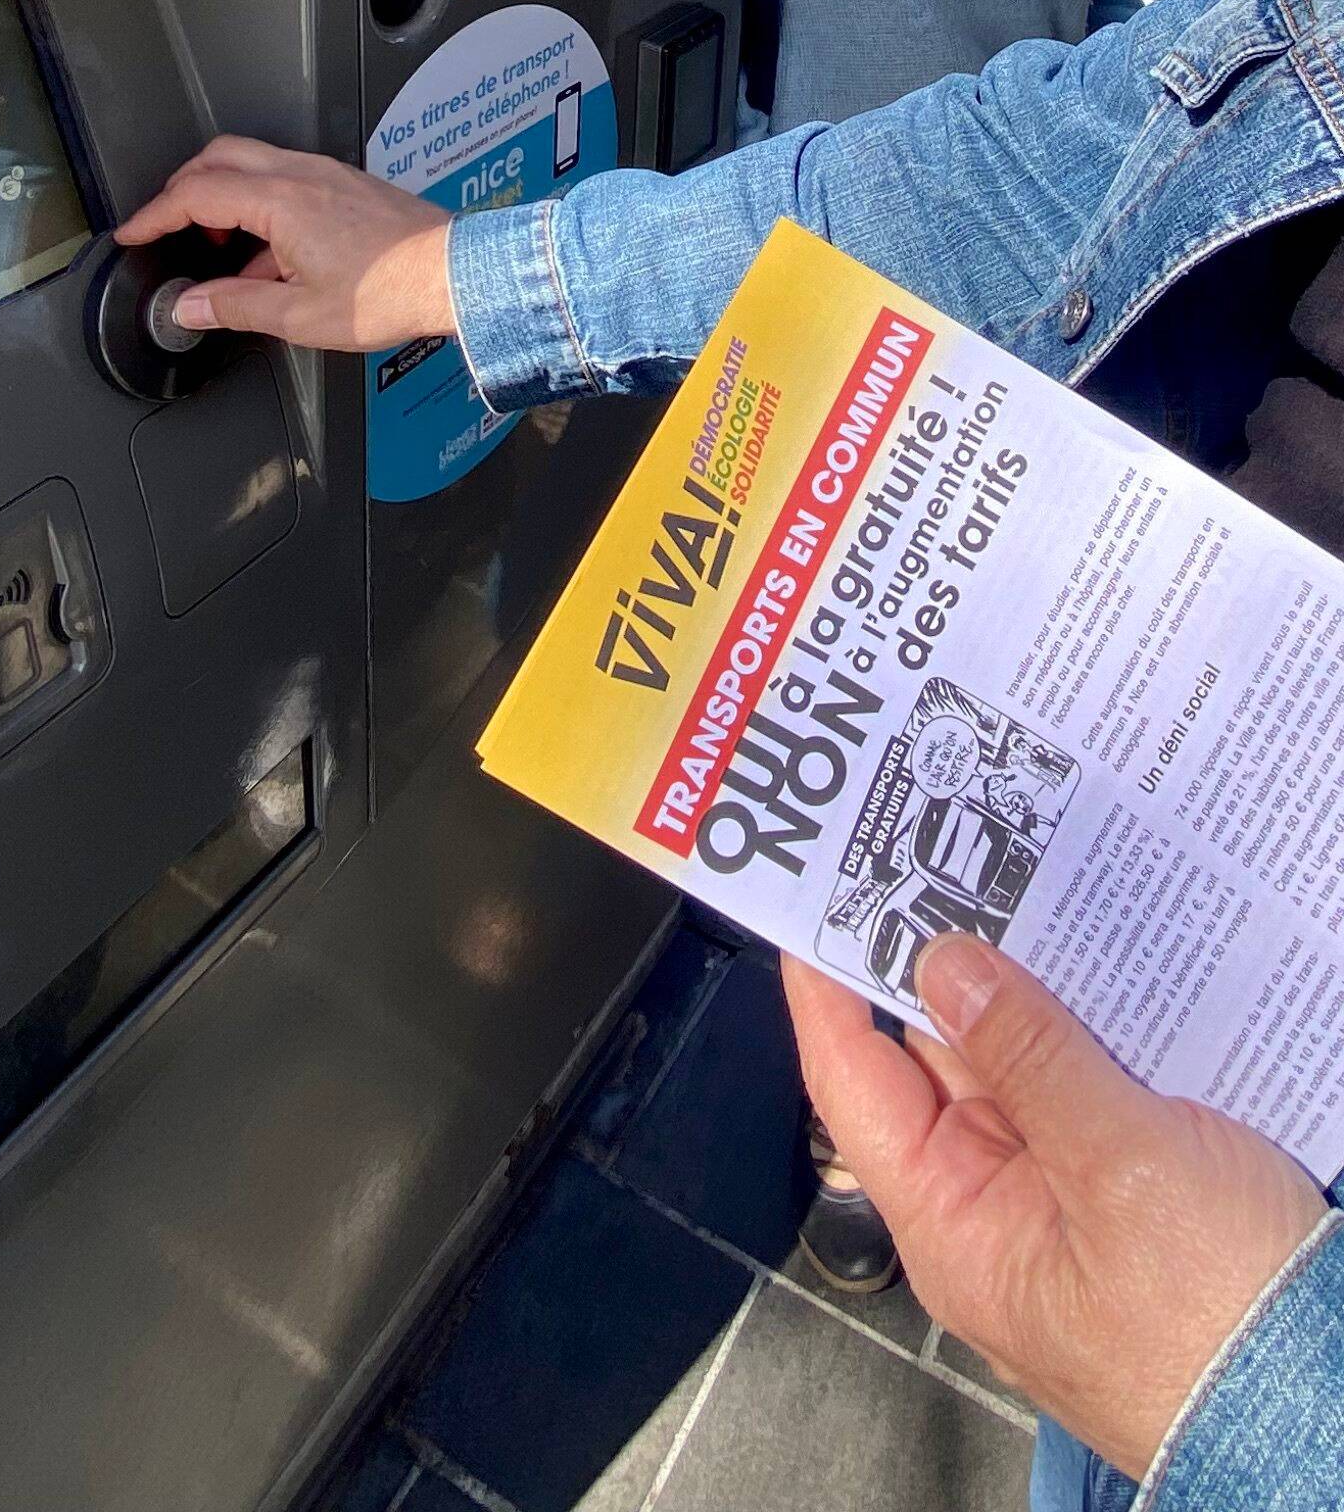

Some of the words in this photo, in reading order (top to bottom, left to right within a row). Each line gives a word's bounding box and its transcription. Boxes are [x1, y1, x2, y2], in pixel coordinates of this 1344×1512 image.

[380, 119, 415, 152] Vos
[422, 89, 470, 129] titres
[475, 74, 497, 99] de
[503, 33, 575, 85] transport
[387, 150, 417, 180] sur
[423, 119, 472, 159] votre
[478, 69, 561, 129] téléphone
[426, 163, 441, 178] Your
[443, 151, 464, 168] travel
[465, 135, 488, 158] passes
[490, 129, 499, 140] on
[499, 121, 514, 137] your
[461, 147, 524, 208] nice
[397, 344, 425, 372] Google
[689, 336, 747, 476] DÉMOCRATIE
[707, 377, 759, 491] ÉCOLOGIE
[730, 380, 780, 504] SOLIDARITÉ
[1139, 476, 1152, 492] un
[896, 571, 959, 670] des
[939, 449, 1026, 570] tarifs
[1099, 540, 1117, 568] pour
[1113, 493, 1142, 539] chercher
[654, 569, 795, 832] TRANSPORTS
[779, 509, 825, 565] EN
[812, 321, 918, 502] COMMUN
[695, 708, 803, 875] OUI
[759, 672, 815, 712] à
[792, 605, 845, 663] la
[831, 406, 946, 608] gratuité
[928, 374, 966, 401] !
[759, 671, 882, 874] NON
[844, 646, 877, 673] à
[862, 382, 1006, 640] l'augmentation
[1005, 652, 1038, 697] travailler,
[1033, 622, 1051, 651] pour
[1046, 584, 1075, 622] étudier,
[1069, 556, 1087, 584] pour
[1084, 540, 1096, 556] se
[1092, 493, 1121, 539] déplacer
[1118, 466, 1137, 493] chez
[1037, 680, 1061, 718] emploi
[1057, 664, 1070, 682] ou
[1066, 637, 1084, 666] pour
[1081, 566, 1123, 637] accompagner
[1117, 538, 1139, 566] leurs
[1136, 497, 1161, 536] enfants
[1155, 486, 1168, 496] à
[1059, 623, 1072, 639] ou
[1066, 612, 1079, 622] à
[1072, 569, 1104, 611] l'hôpital,
[1081, 721, 1103, 750] Cette
[1099, 650, 1142, 720] augmentation
[1137, 632, 1152, 649] du
[1147, 607, 1166, 633] coût
[1160, 586, 1177, 608] des
[1171, 533, 1206, 586] transports
[1202, 517, 1215, 533] en
[1021, 686, 1038, 708] son
[1034, 640, 1063, 686] médecin
[1050, 694, 1075, 729] l'école
[1070, 670, 1089, 695] sera
[1084, 633, 1109, 670] encore
[1104, 610, 1121, 635] plus
[1117, 584, 1136, 610] cher.
[1138, 766, 1164, 794] Un
[1158, 720, 1188, 765] déni
[1182, 662, 1220, 721] social
[844, 842, 864, 873] DES
[856, 742, 904, 839] TRANSPORTS
[871, 780, 908, 853] GRATUITS
